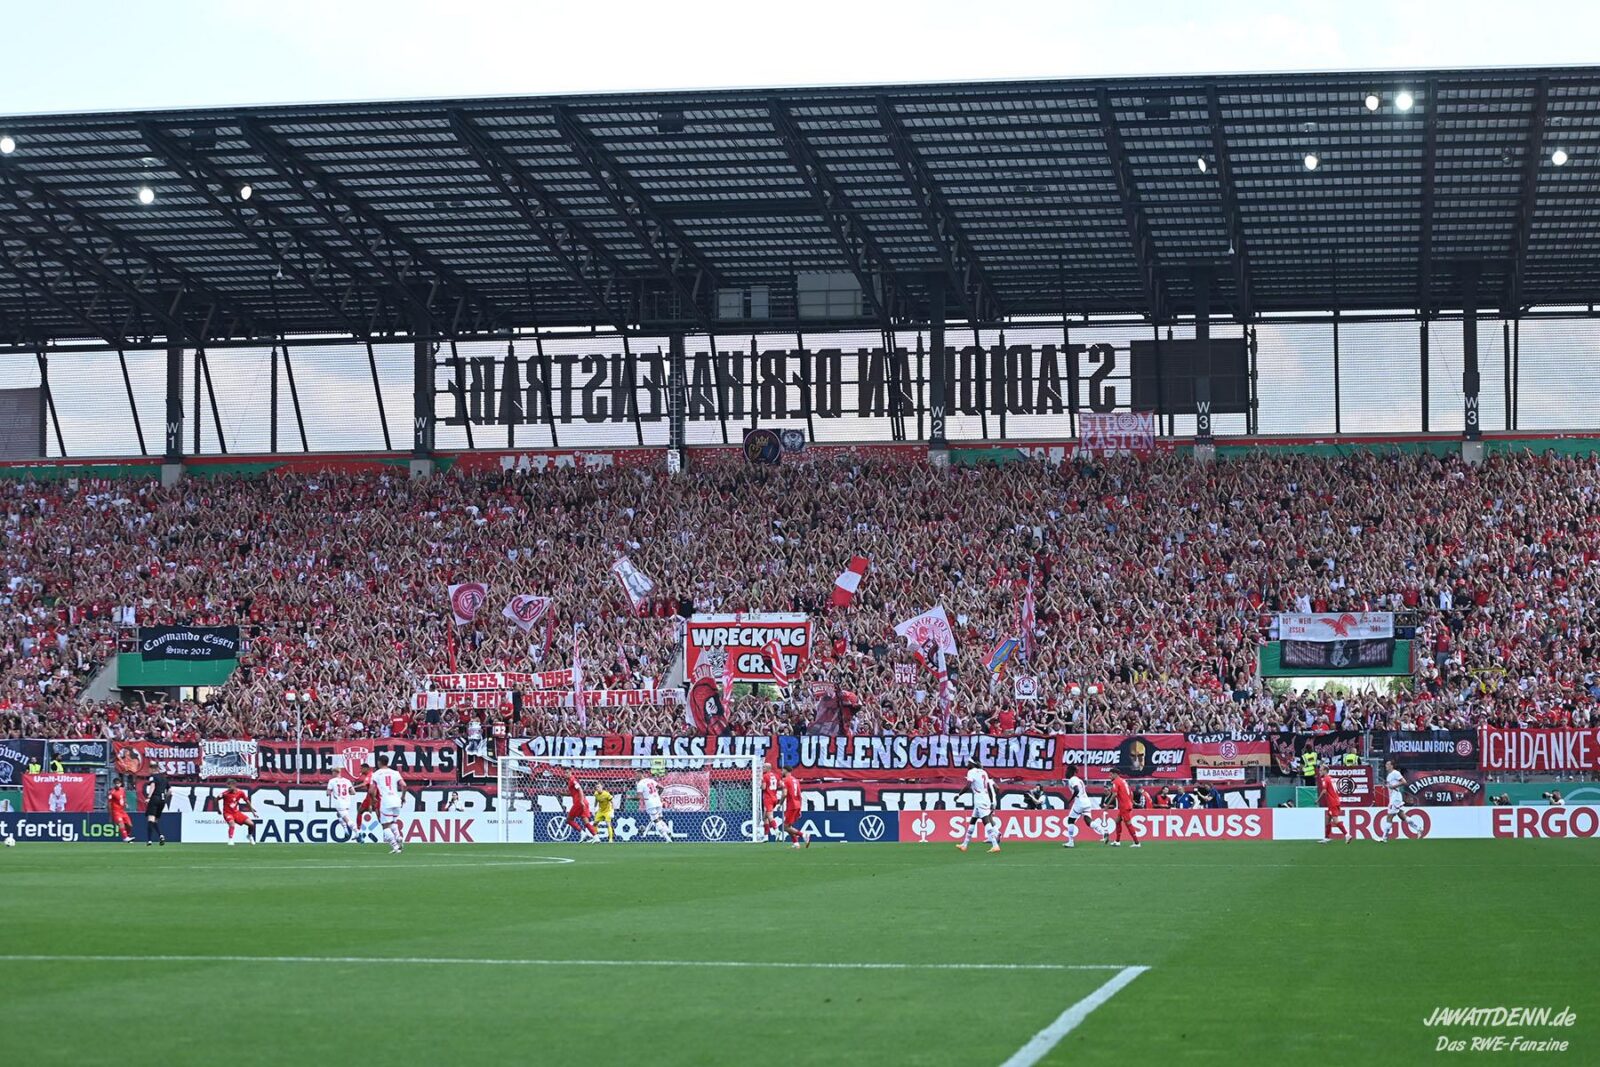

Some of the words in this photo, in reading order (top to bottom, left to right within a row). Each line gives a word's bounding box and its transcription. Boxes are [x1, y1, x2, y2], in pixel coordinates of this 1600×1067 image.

[1197, 401, 1210, 413] W
[1465, 396, 1478, 409] W
[931, 406, 945, 418] W
[1467, 410, 1477, 425] 3
[167, 422, 179, 434] W
[414, 416, 427, 429] W
[933, 419, 943, 433] 2
[1079, 414, 1153, 431] STROM
[1199, 416, 1209, 430] 3
[169, 435, 176, 449] 1
[417, 430, 423, 444] 1
[1080, 431, 1154, 449] KASTEN
[143, 631, 200, 651] Commando
[202, 633, 235, 650] Essen
[691, 627, 806, 647] WRECKING
[165, 645, 189, 655] Since
[737, 653, 798, 674] CRW
[463, 673, 498, 689] 1953
[895, 674, 917, 684] RWE
[632, 735, 705, 769] HASS
[713, 734, 771, 769] AUF
[779, 734, 1055, 770] BULLENSCHWEINE!
[1389, 737, 1433, 753] ADRENALIN
[1434, 740, 1454, 753] BOYS
[1482, 730, 1516, 769] ICH
[1520, 730, 1593, 769] DANKE
[259, 746, 333, 774] RUDE
[374, 745, 455, 773] FANS
[1151, 749, 1184, 764] CREW
[158, 760, 196, 775] SSEN
[33, 775, 83, 783] Uralt-Ultras
[1408, 775, 1481, 794] DAUERBRENNER
[1436, 791, 1452, 802] 97A
[17, 819, 79, 841] fertig,
[83, 819, 119, 837] los!
[949, 815, 1079, 839] STRAUSS
[1131, 813, 1262, 838] STRAUSS
[1324, 808, 1432, 839] ERGO
[1492, 807, 1600, 839] ERGO
